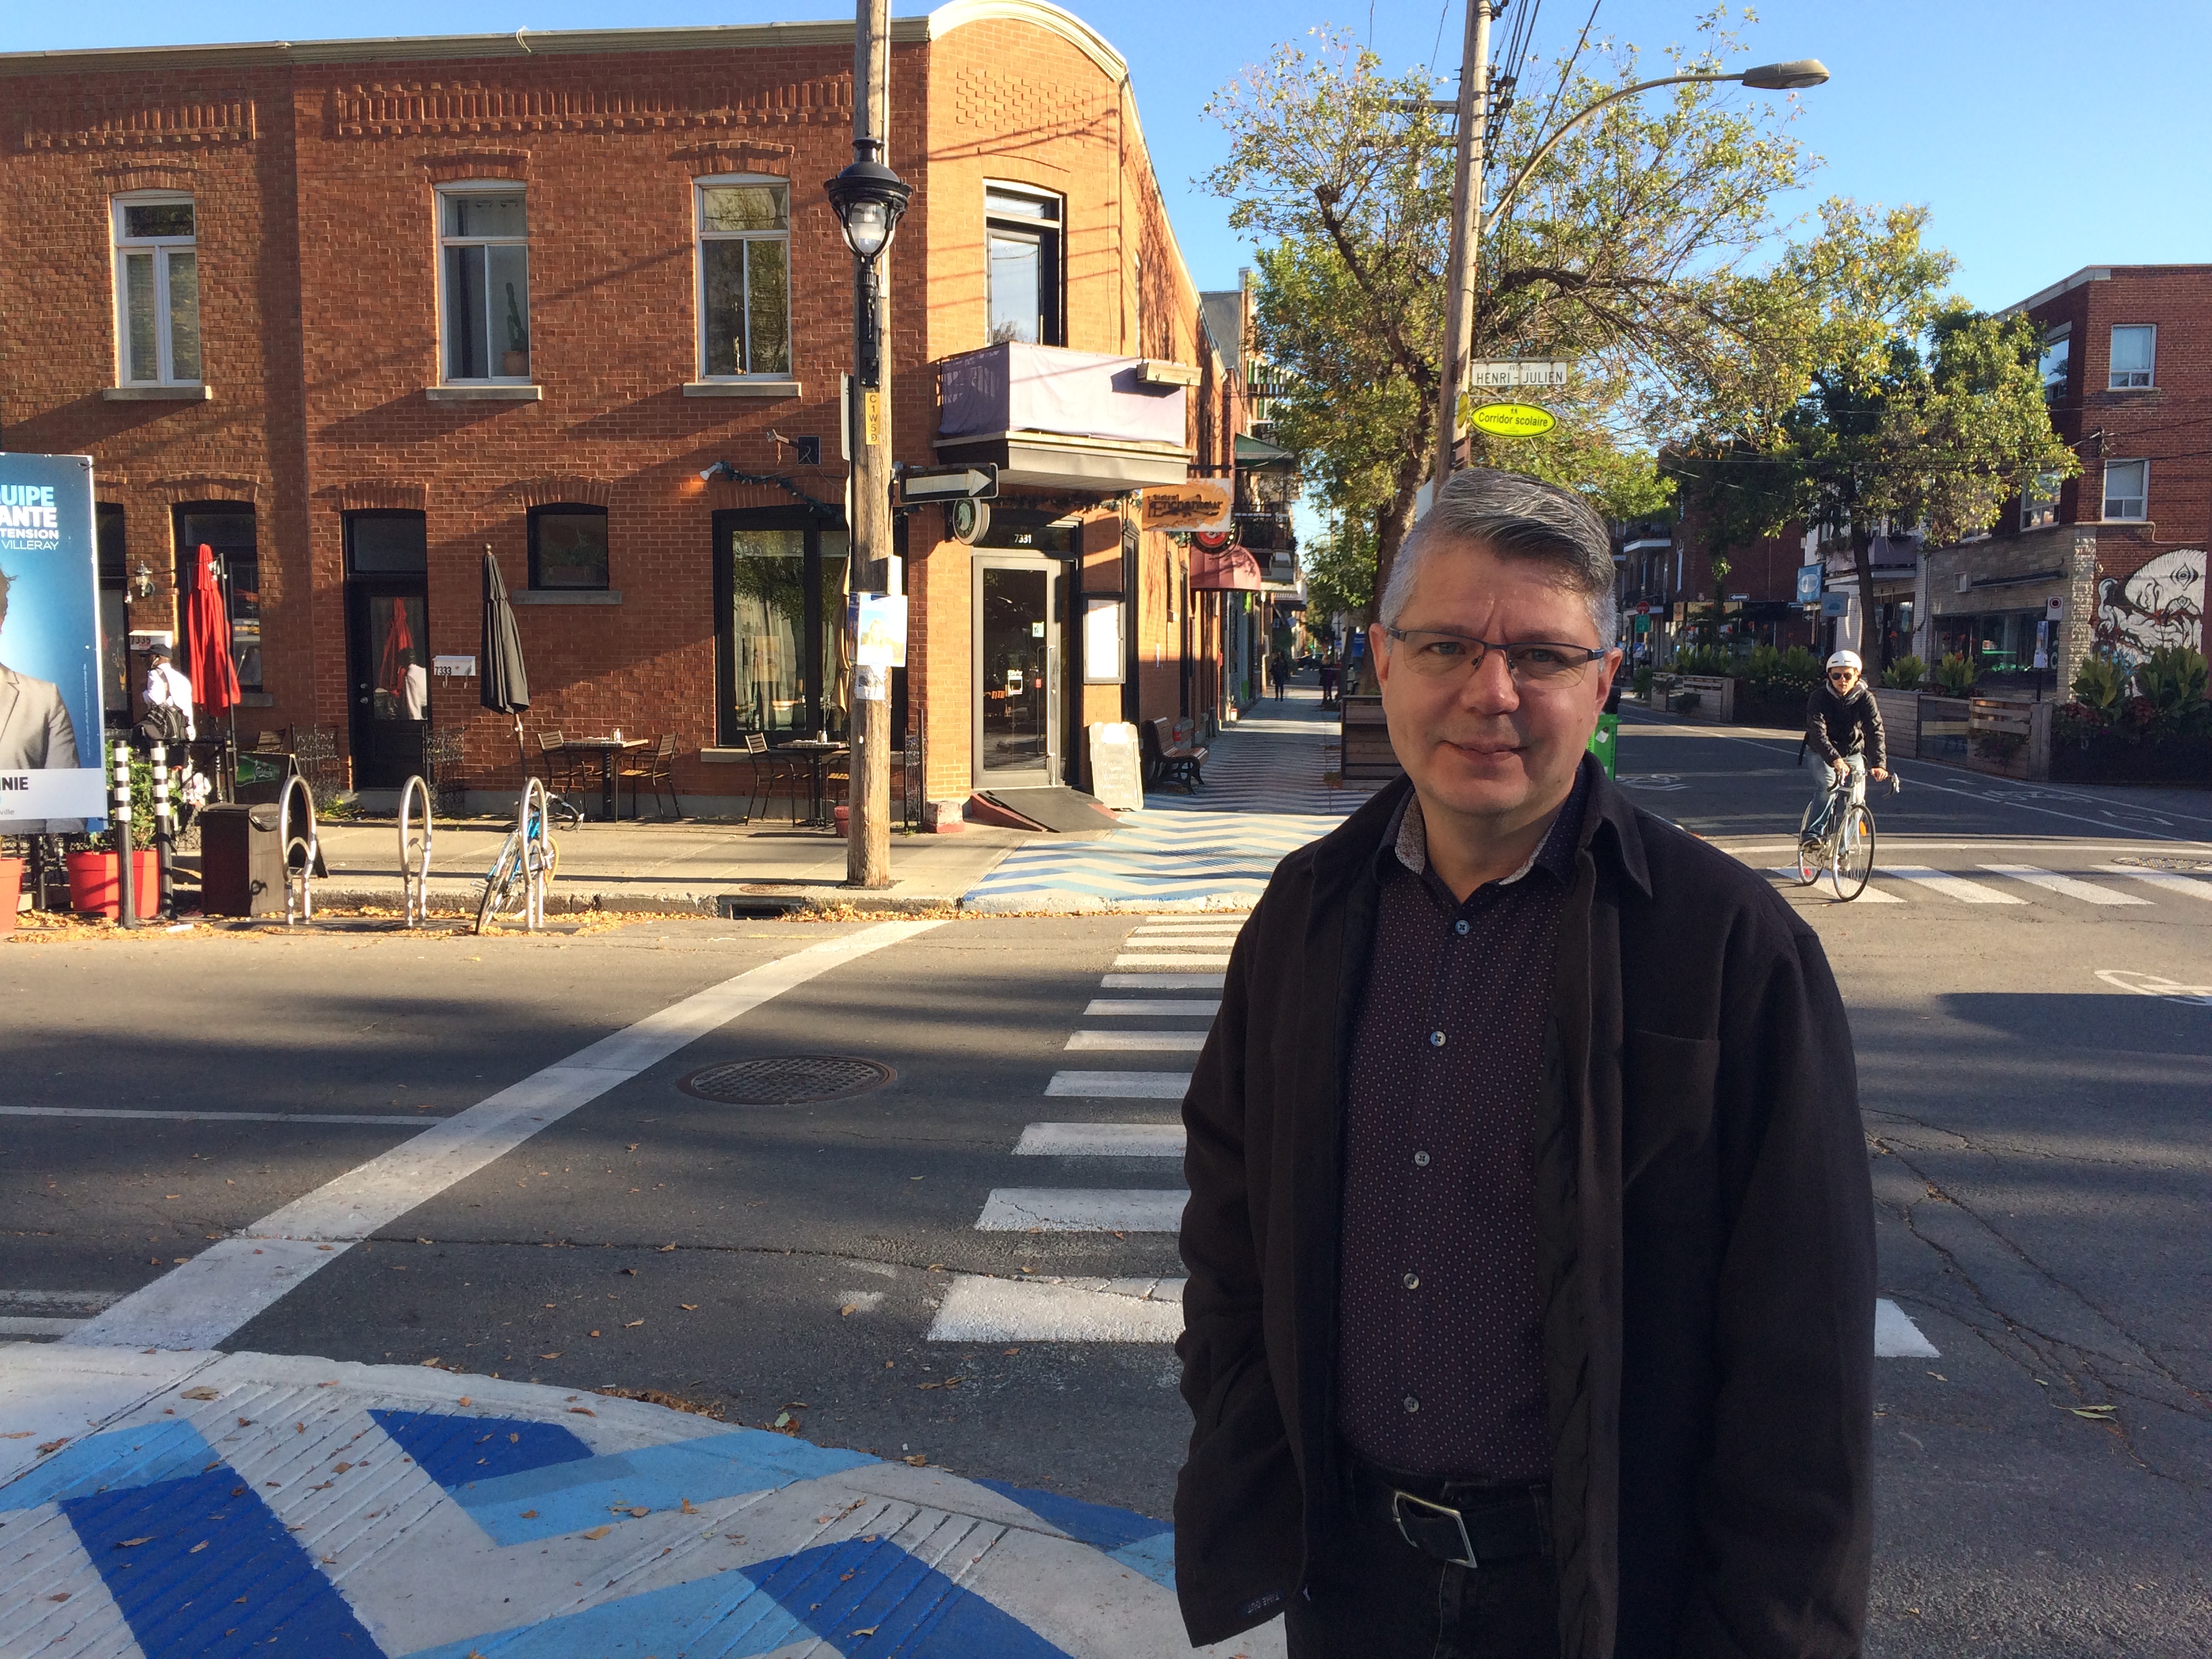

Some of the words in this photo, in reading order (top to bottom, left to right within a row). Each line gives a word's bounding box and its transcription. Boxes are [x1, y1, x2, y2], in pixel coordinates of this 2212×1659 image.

[1478, 411, 1513, 425] Corridor
[1515, 415, 1549, 427] scolaire
[0, 485, 54, 507] UIPE
[1014, 533, 1032, 544] 7331
[1, 539, 59, 551] VILLERAY
[130, 635, 151, 645] 7335
[434, 665, 452, 676] 7333
[0, 777, 29, 791] NIE
